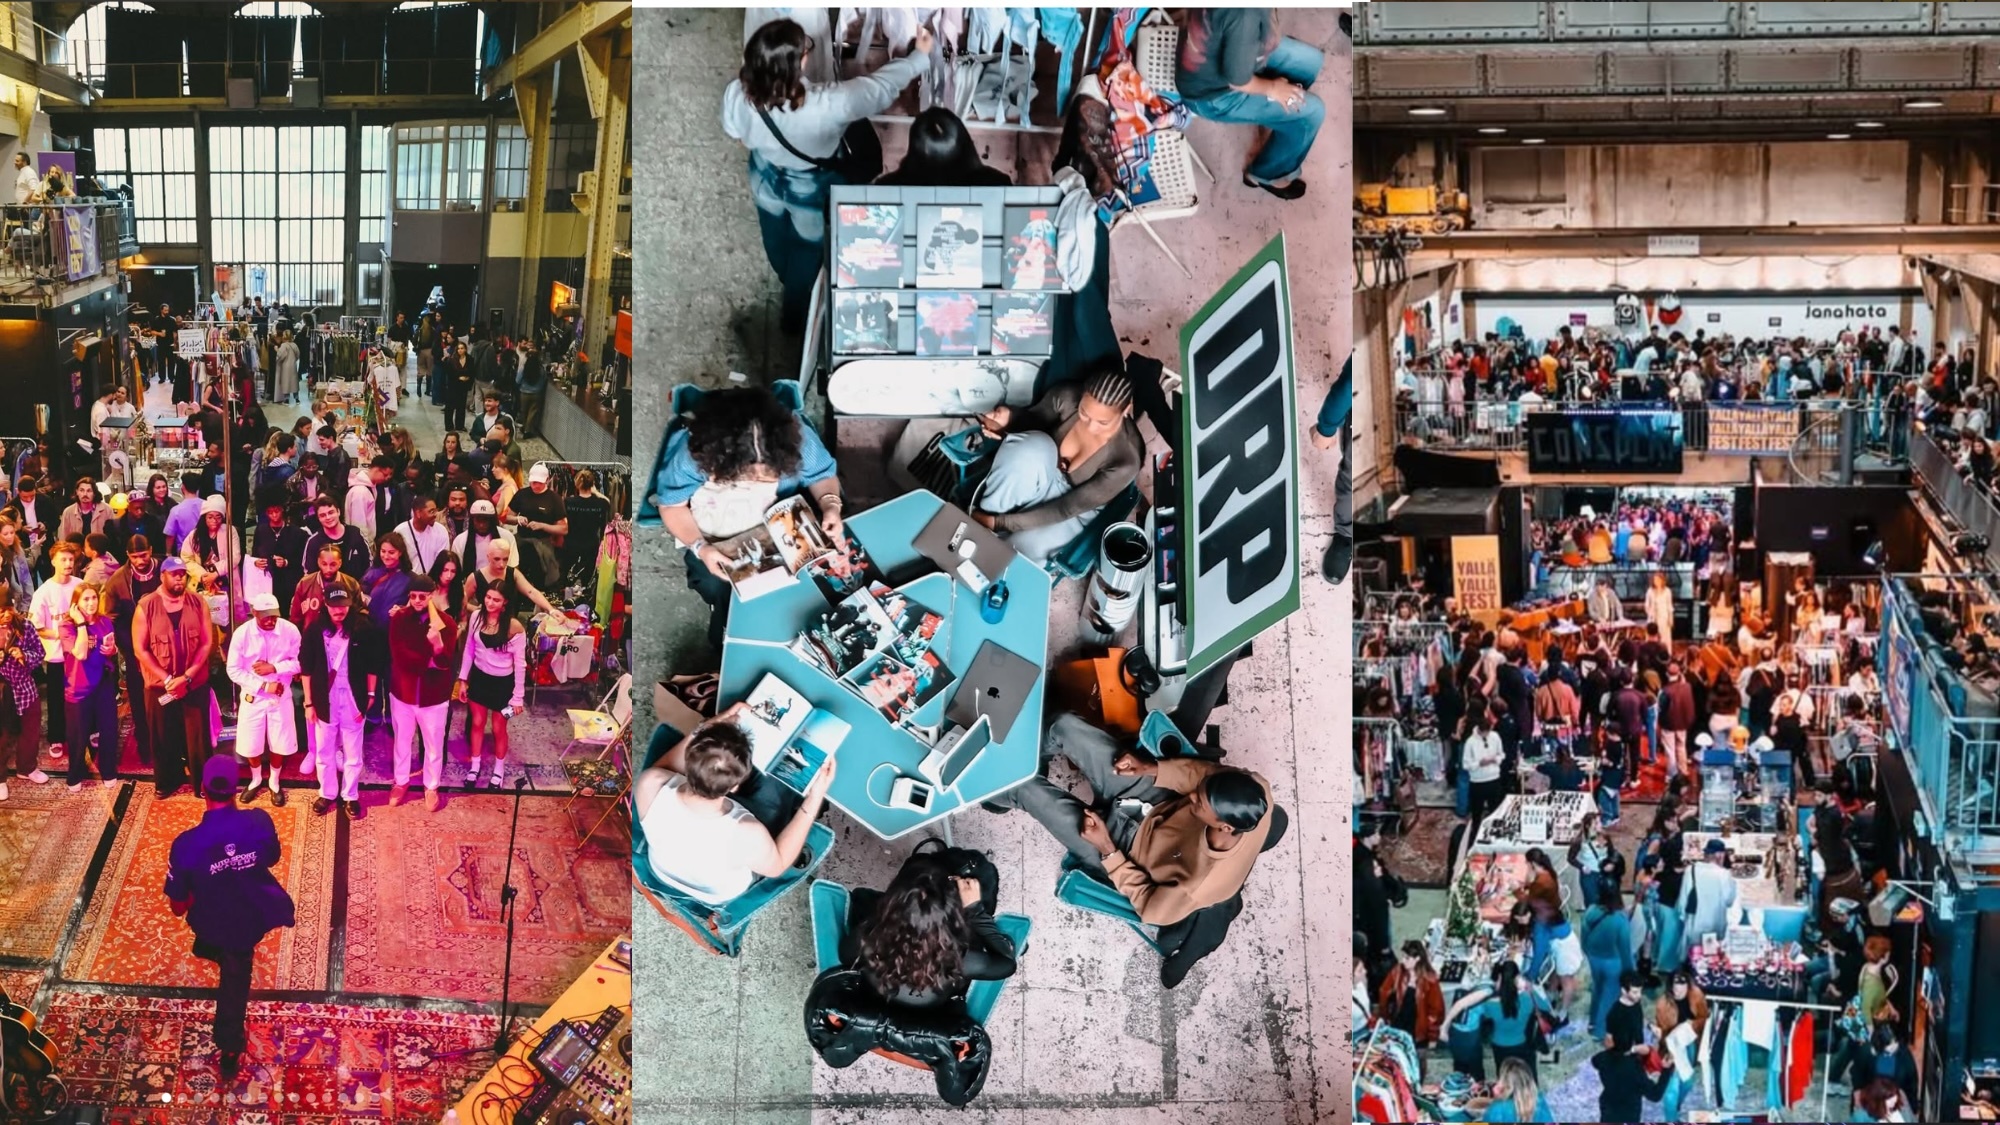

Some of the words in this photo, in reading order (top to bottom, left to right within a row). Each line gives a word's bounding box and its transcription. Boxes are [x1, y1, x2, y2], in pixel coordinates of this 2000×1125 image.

[1805, 300, 1887, 319] janahata
[1193, 279, 1288, 605] DRP
[1461, 593, 1497, 609] FEST
[210, 858, 230, 871] AUTO
[230, 851, 257, 862] SPORT
